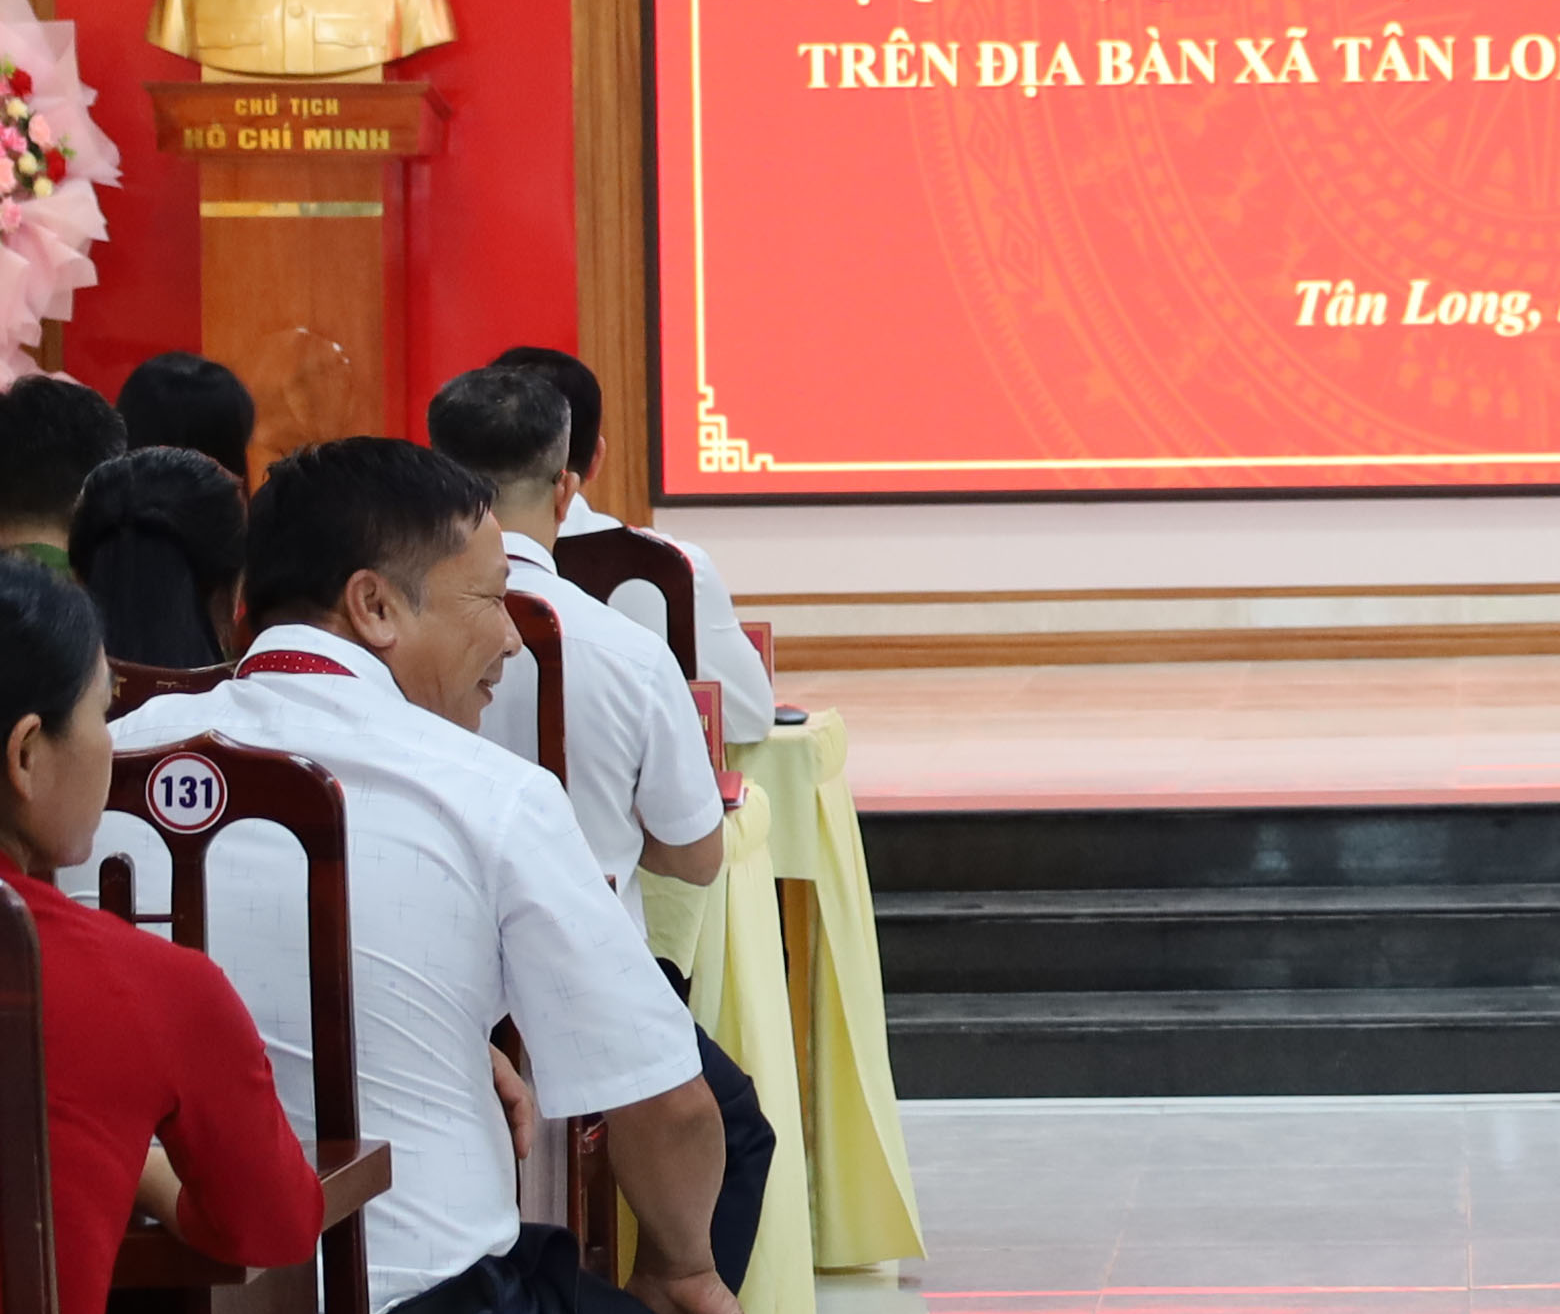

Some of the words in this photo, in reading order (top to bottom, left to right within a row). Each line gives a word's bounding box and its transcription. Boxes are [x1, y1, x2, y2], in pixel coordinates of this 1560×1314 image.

[798, 27, 959, 88] TRÊN
[976, 41, 1084, 97] ĐỊA
[1097, 27, 1216, 85] BÀN
[1235, 27, 1318, 83] XÃ
[1333, 22, 1455, 82] TÂN
[290, 98, 338, 118] TỊCH
[238, 122, 292, 149] CHÍ
[304, 129, 389, 149] MINH
[1296, 279, 1387, 326] Tân
[1402, 279, 1541, 336] Long,
[160, 775, 212, 809] 131
